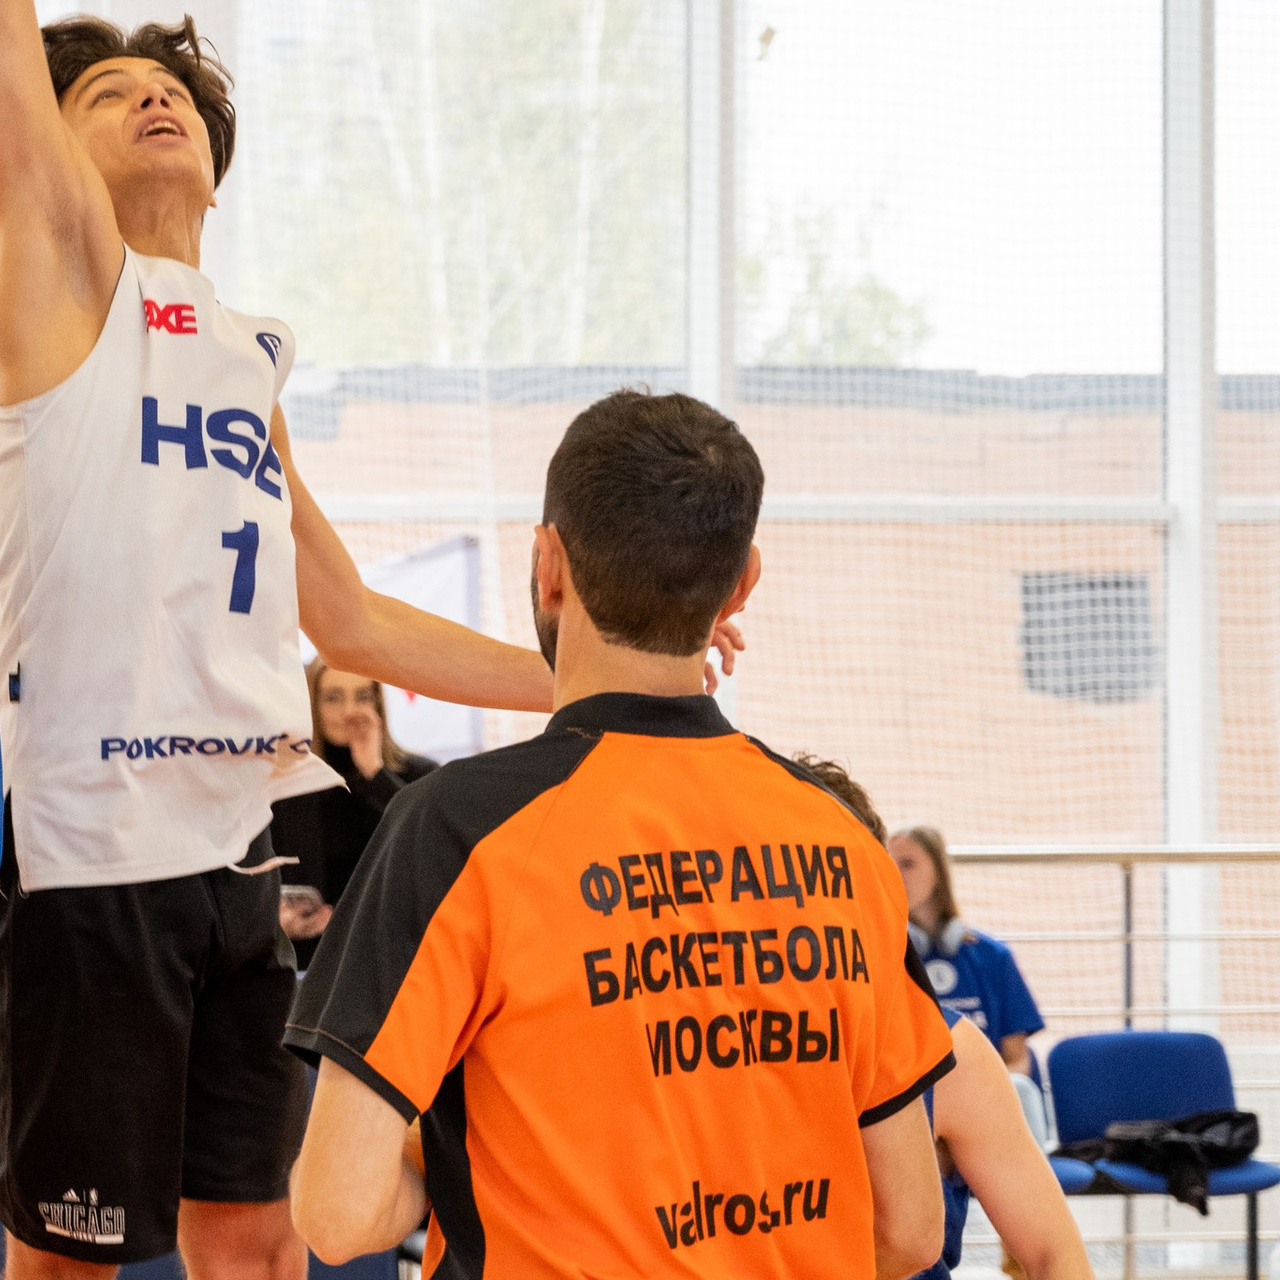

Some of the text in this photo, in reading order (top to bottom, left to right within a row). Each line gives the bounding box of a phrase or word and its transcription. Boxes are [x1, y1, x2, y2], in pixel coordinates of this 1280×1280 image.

[141, 395, 283, 502] HSE
[221, 520, 260, 614] 1
[579, 844, 854, 918] ФЕДЕРАЦИЯ
[583, 925, 870, 1008] БАСКЕТБОЛА
[38, 1201, 126, 1235] CHICAGO
[655, 1178, 831, 1250] valros.ru
